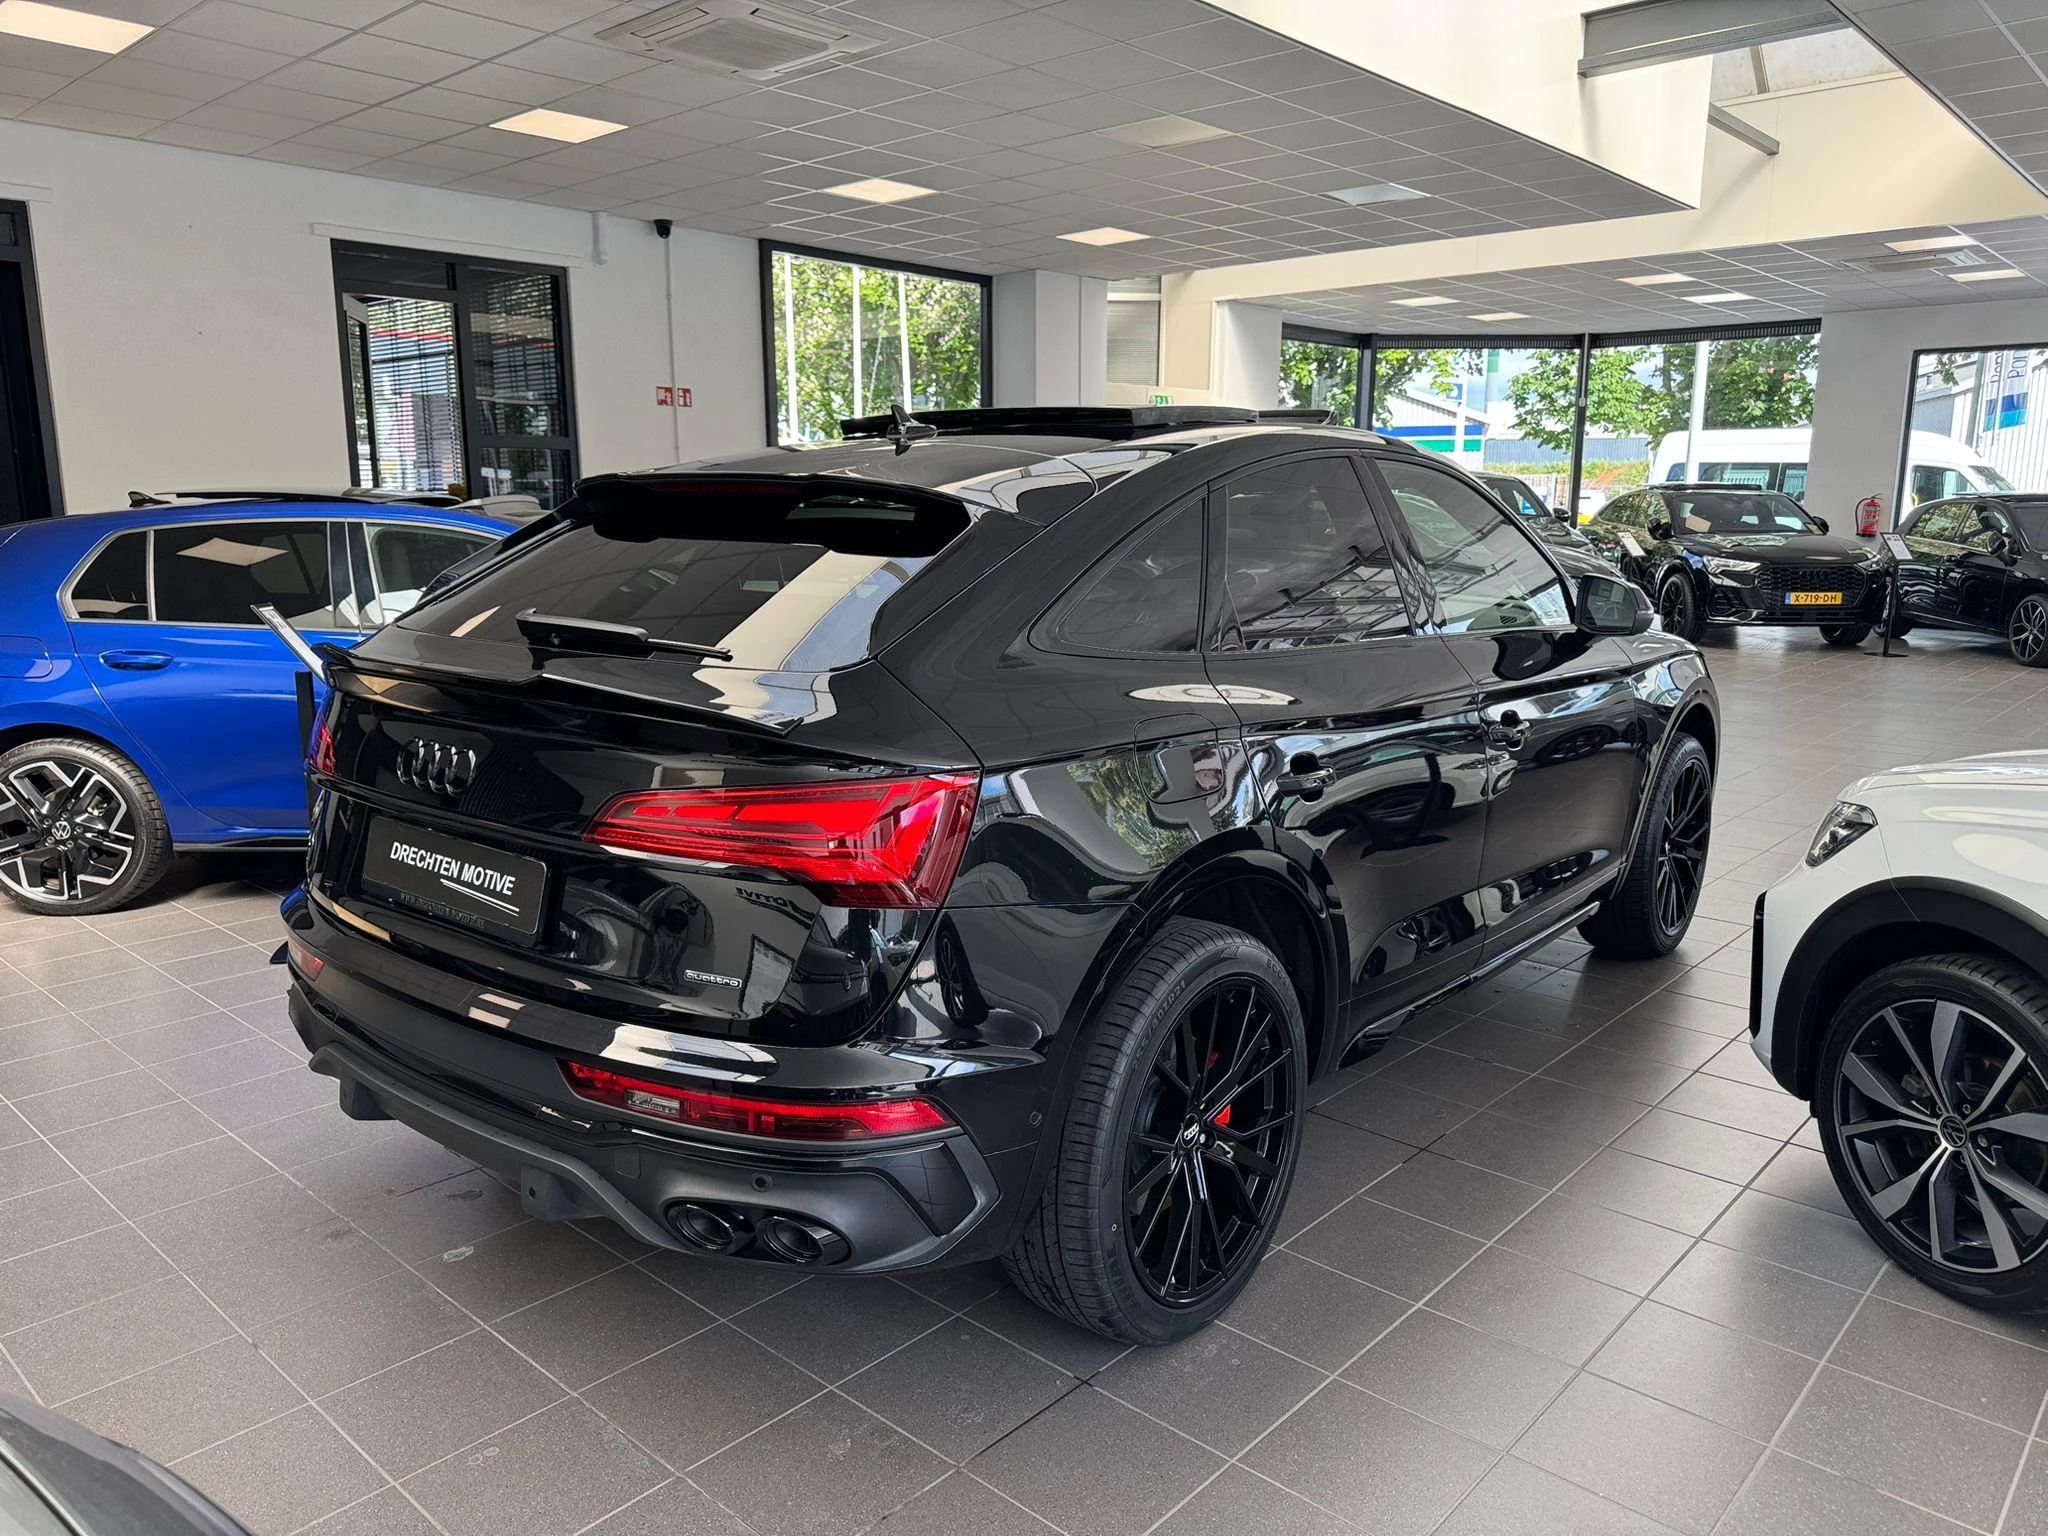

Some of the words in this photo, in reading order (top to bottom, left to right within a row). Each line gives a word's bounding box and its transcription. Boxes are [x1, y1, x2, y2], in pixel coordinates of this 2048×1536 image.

[1794, 594, 1837, 603] X-719-DH
[389, 841, 461, 879] DRECHTEN
[461, 862, 516, 896] MOTIVE
[686, 972, 738, 987] quattro
